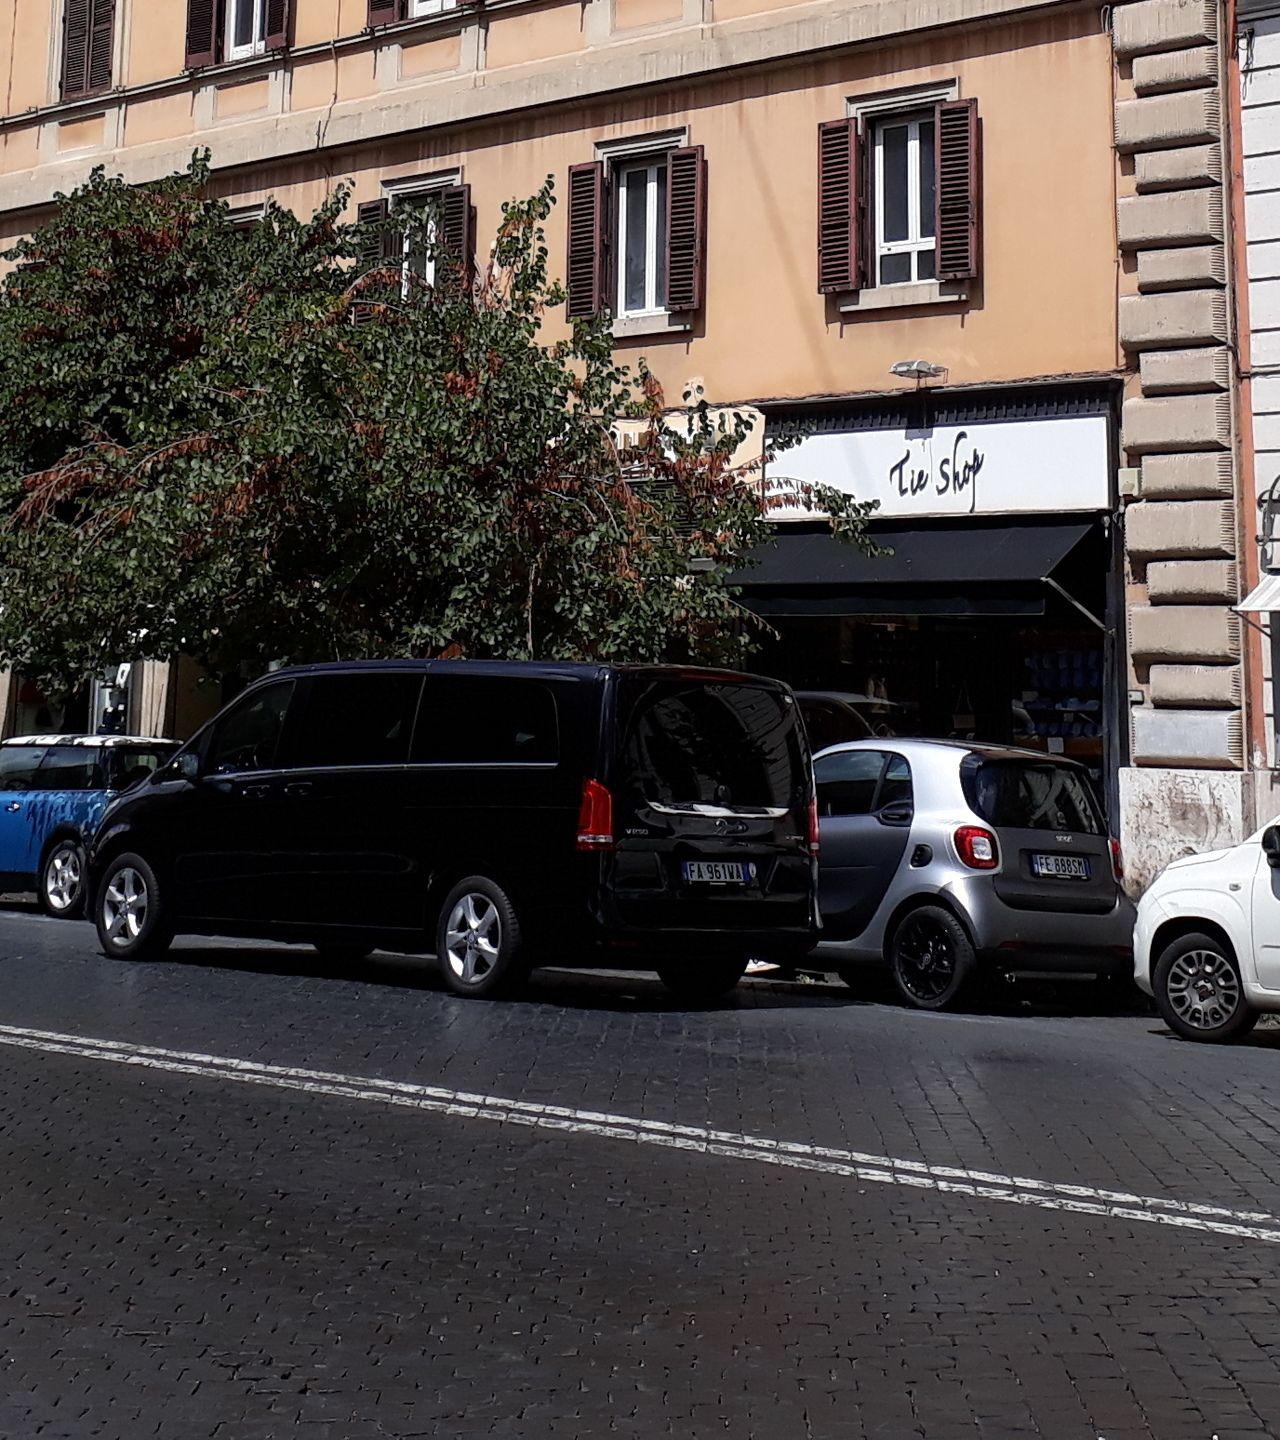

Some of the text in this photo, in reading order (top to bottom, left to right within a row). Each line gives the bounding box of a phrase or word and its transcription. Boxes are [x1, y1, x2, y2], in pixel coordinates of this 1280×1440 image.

[889, 430, 985, 514] Tie Shop
[689, 863, 704, 880] FA
